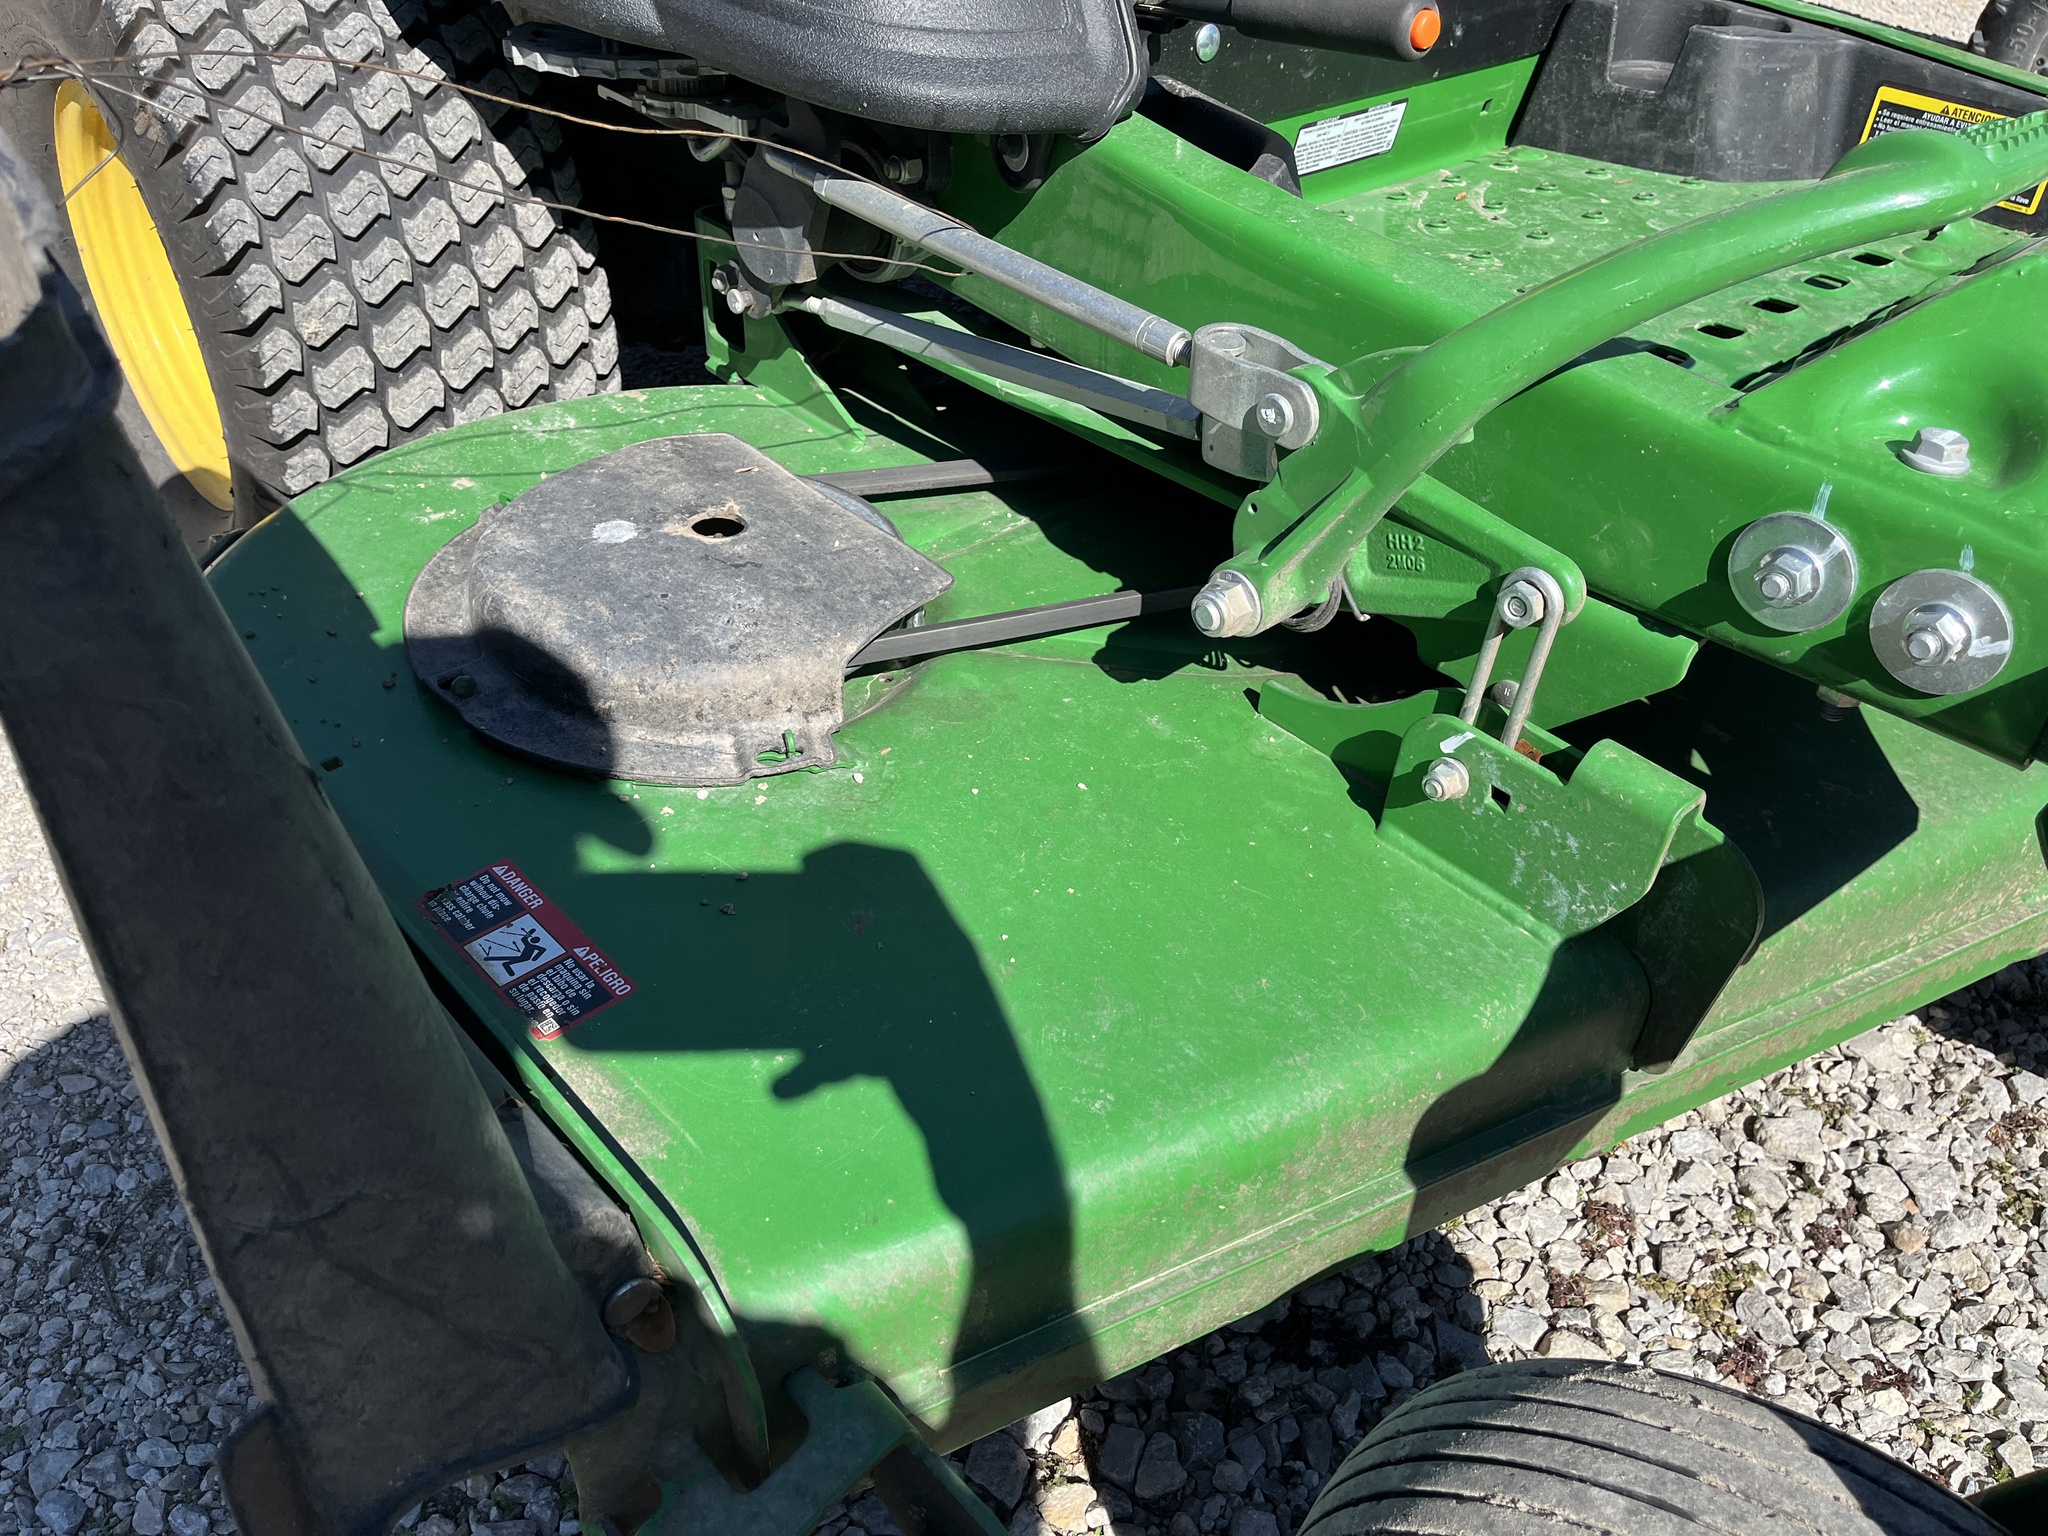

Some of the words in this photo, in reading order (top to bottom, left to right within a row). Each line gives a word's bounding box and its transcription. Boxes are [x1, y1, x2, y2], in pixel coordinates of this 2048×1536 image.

[1880, 116, 1893, 125] Leer
[1891, 111, 1915, 122] requiere
[1922, 112, 1950, 125] AYUDAR
[1386, 534, 1425, 551] HH2
[456, 896, 474, 914] entire
[459, 885, 480, 906] charge
[476, 901, 495, 920] chute
[469, 880, 493, 901] without
[487, 896, 501, 911] dis-
[480, 874, 491, 885] Do
[487, 883, 500, 894] not
[495, 891, 513, 907] mow
[501, 870, 544, 909] DANGER
[545, 967, 555, 976] el
[552, 973, 569, 991] tubo
[565, 987, 577, 998] de
[563, 957, 573, 969] No
[571, 966, 589, 983] usar
[585, 979, 595, 990] la
[582, 952, 632, 996] PELIGRO
[508, 987, 520, 999] su
[518, 982, 529, 993] de
[526, 990, 546, 1010] pasto
[542, 1006, 555, 1018] en
[527, 977, 536, 986] el
[533, 983, 567, 1016] recogedor
[536, 972, 566, 1002] descarga
[566, 1003, 580, 1016] sin
[578, 987, 592, 1000] sin
